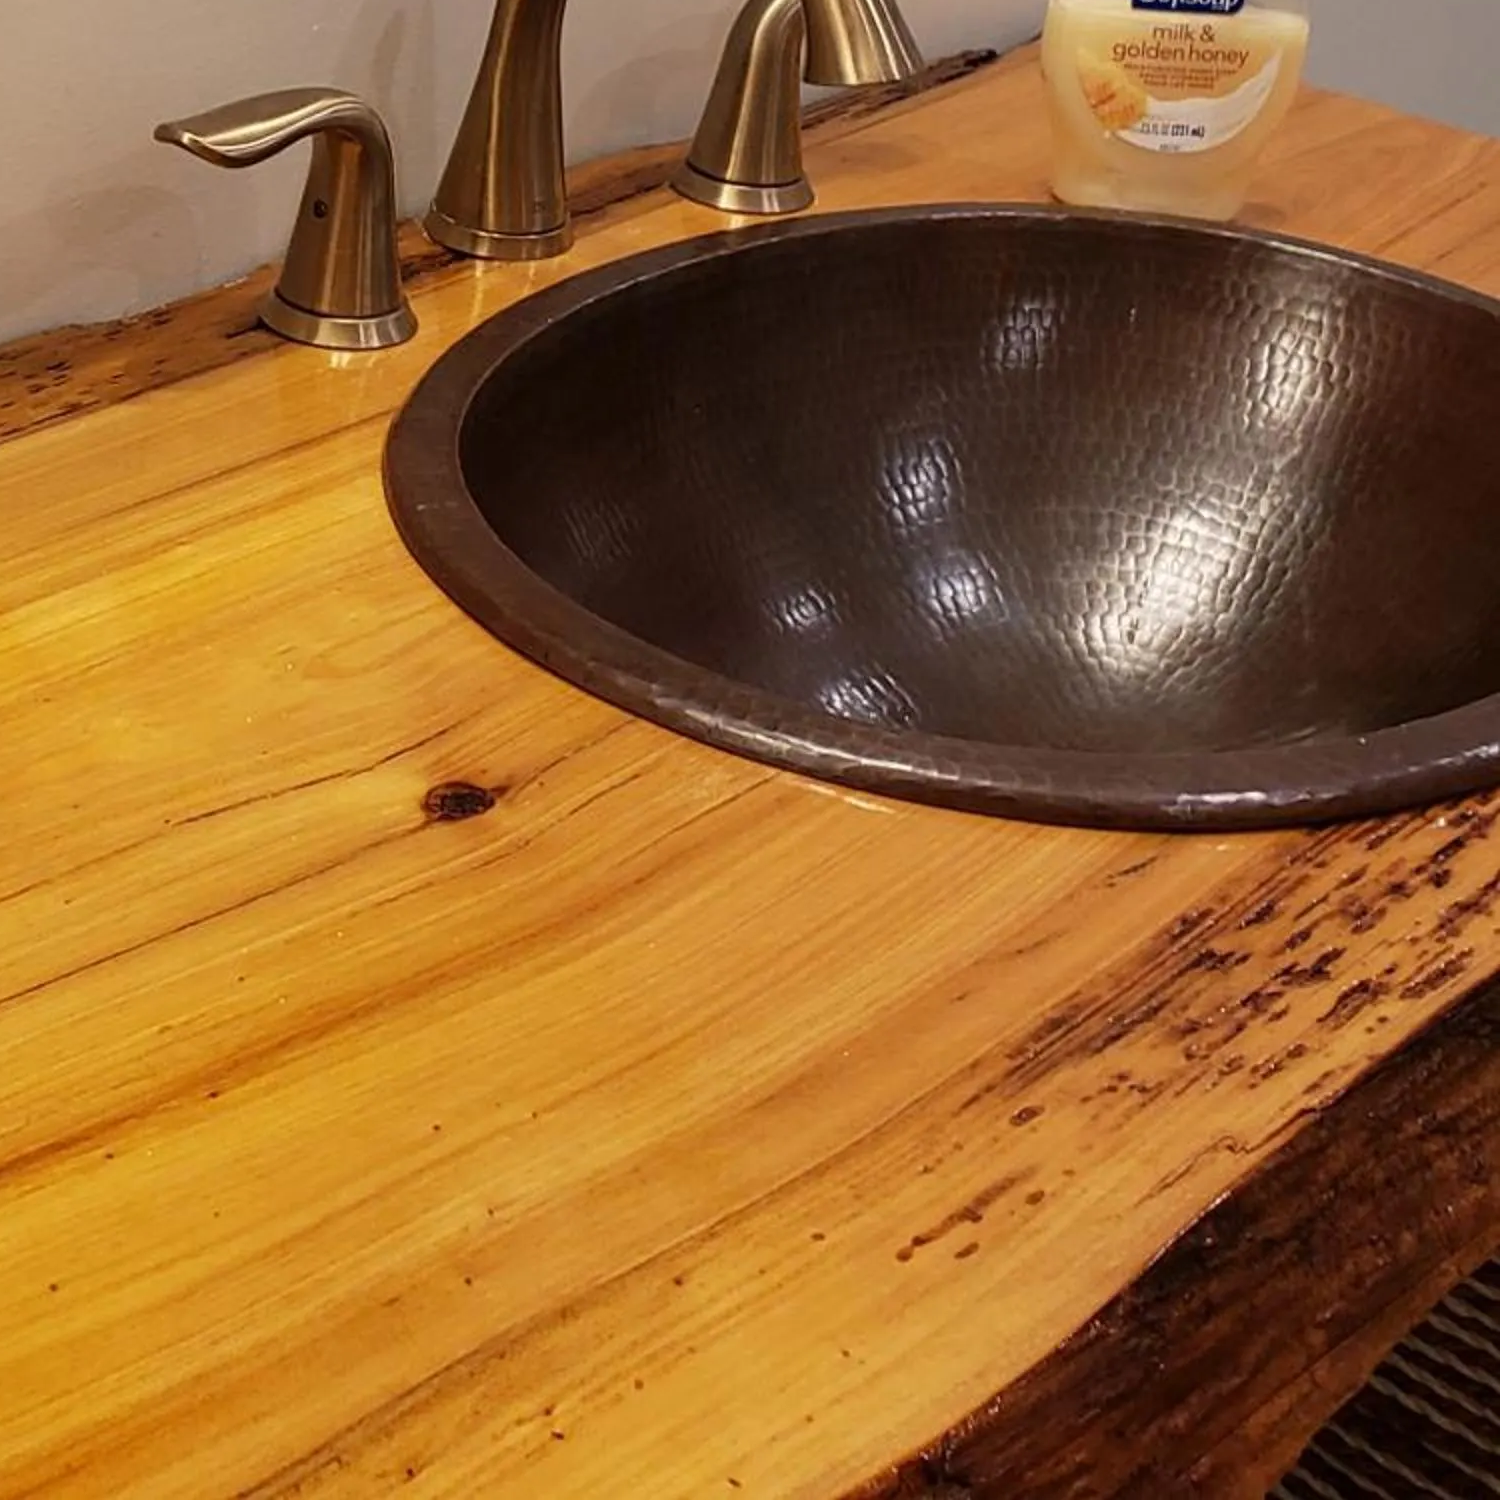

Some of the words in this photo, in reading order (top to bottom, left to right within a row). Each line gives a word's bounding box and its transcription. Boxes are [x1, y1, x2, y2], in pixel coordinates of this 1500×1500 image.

[1153, 23, 1195, 41] milk
[1199, 24, 1215, 42] &
[1112, 40, 1185, 62] golden
[1189, 43, 1250, 68] honey
